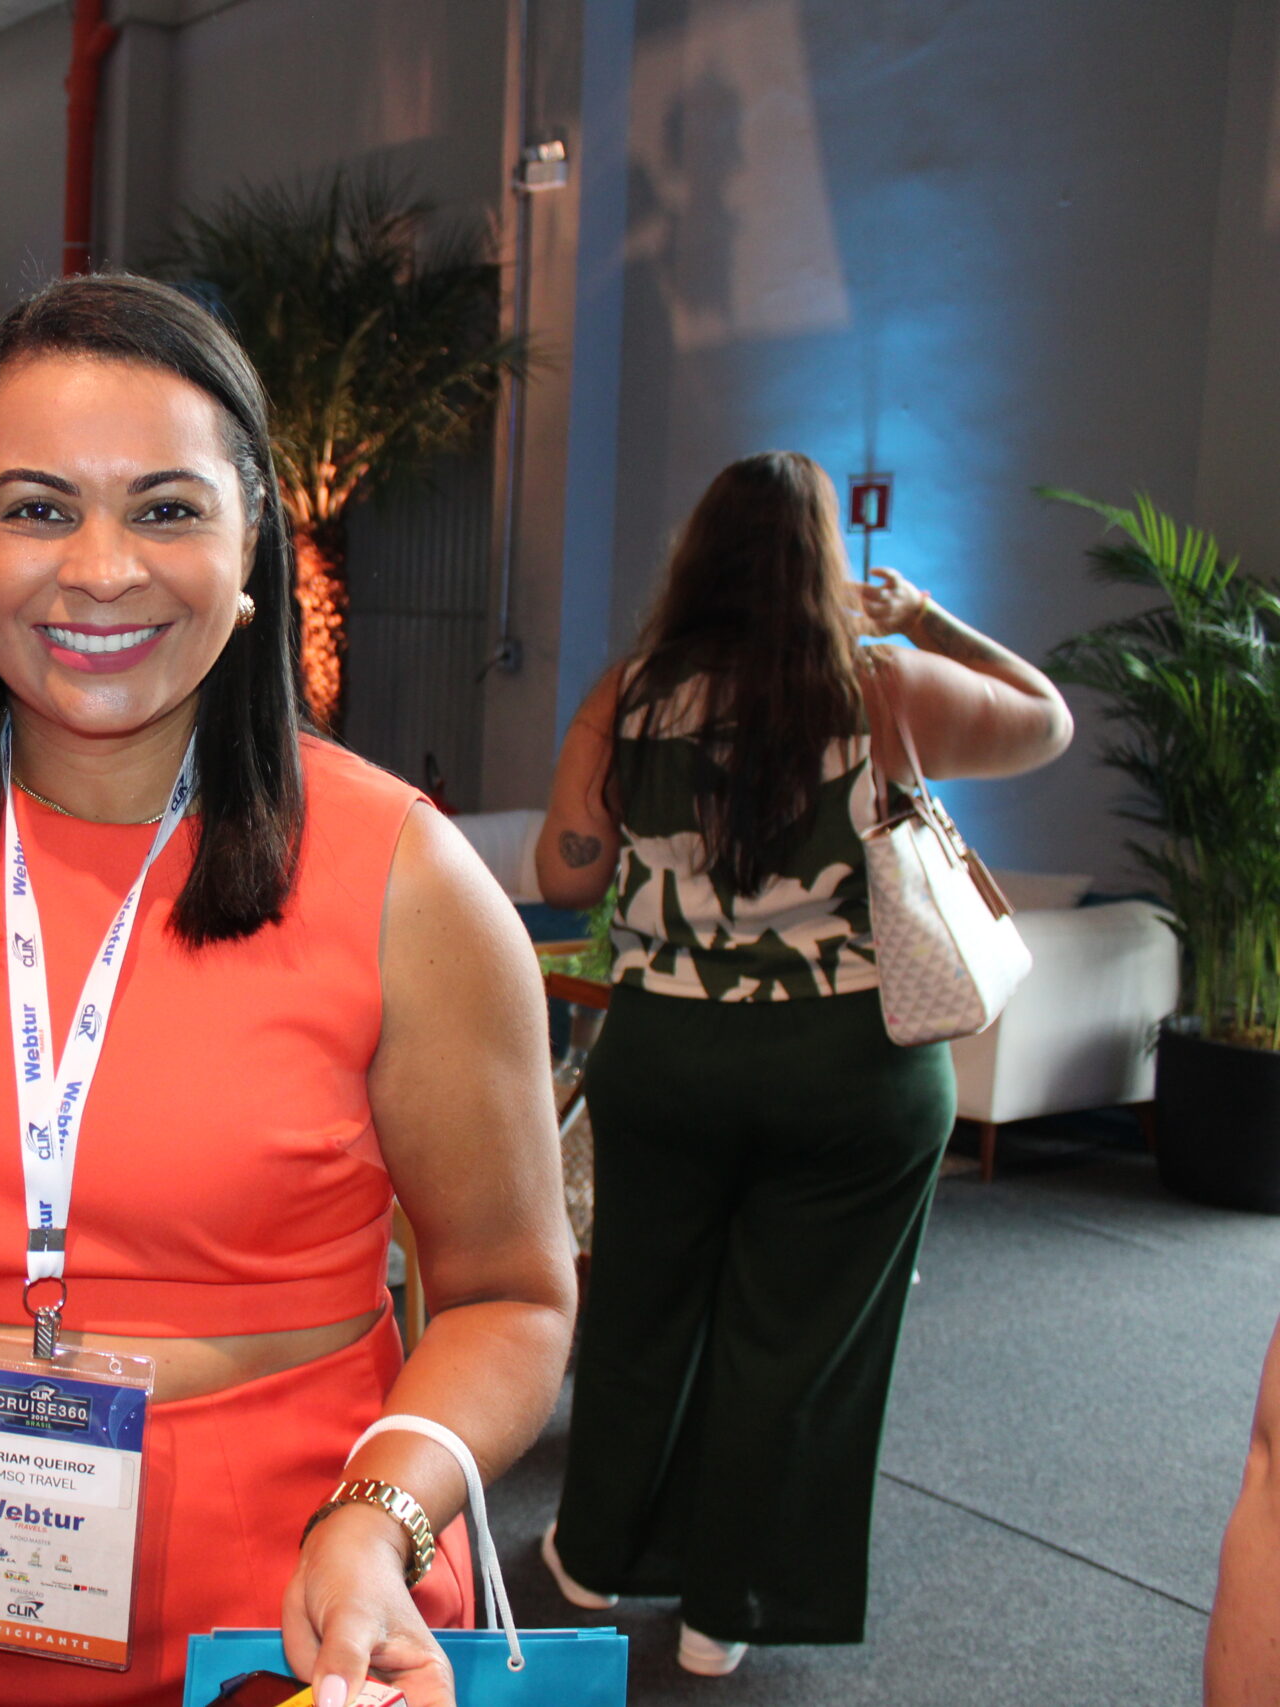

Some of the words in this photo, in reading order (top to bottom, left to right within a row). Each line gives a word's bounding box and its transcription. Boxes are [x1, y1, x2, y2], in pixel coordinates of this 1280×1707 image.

[22, 1004, 41, 1083] Webtur
[25, 1419, 52, 1429] BRASIL
[33, 1456, 96, 1475] QUEIROZ
[29, 1473, 77, 1490] TRAVEL
[14, 1522, 48, 1533] TRAVELS
